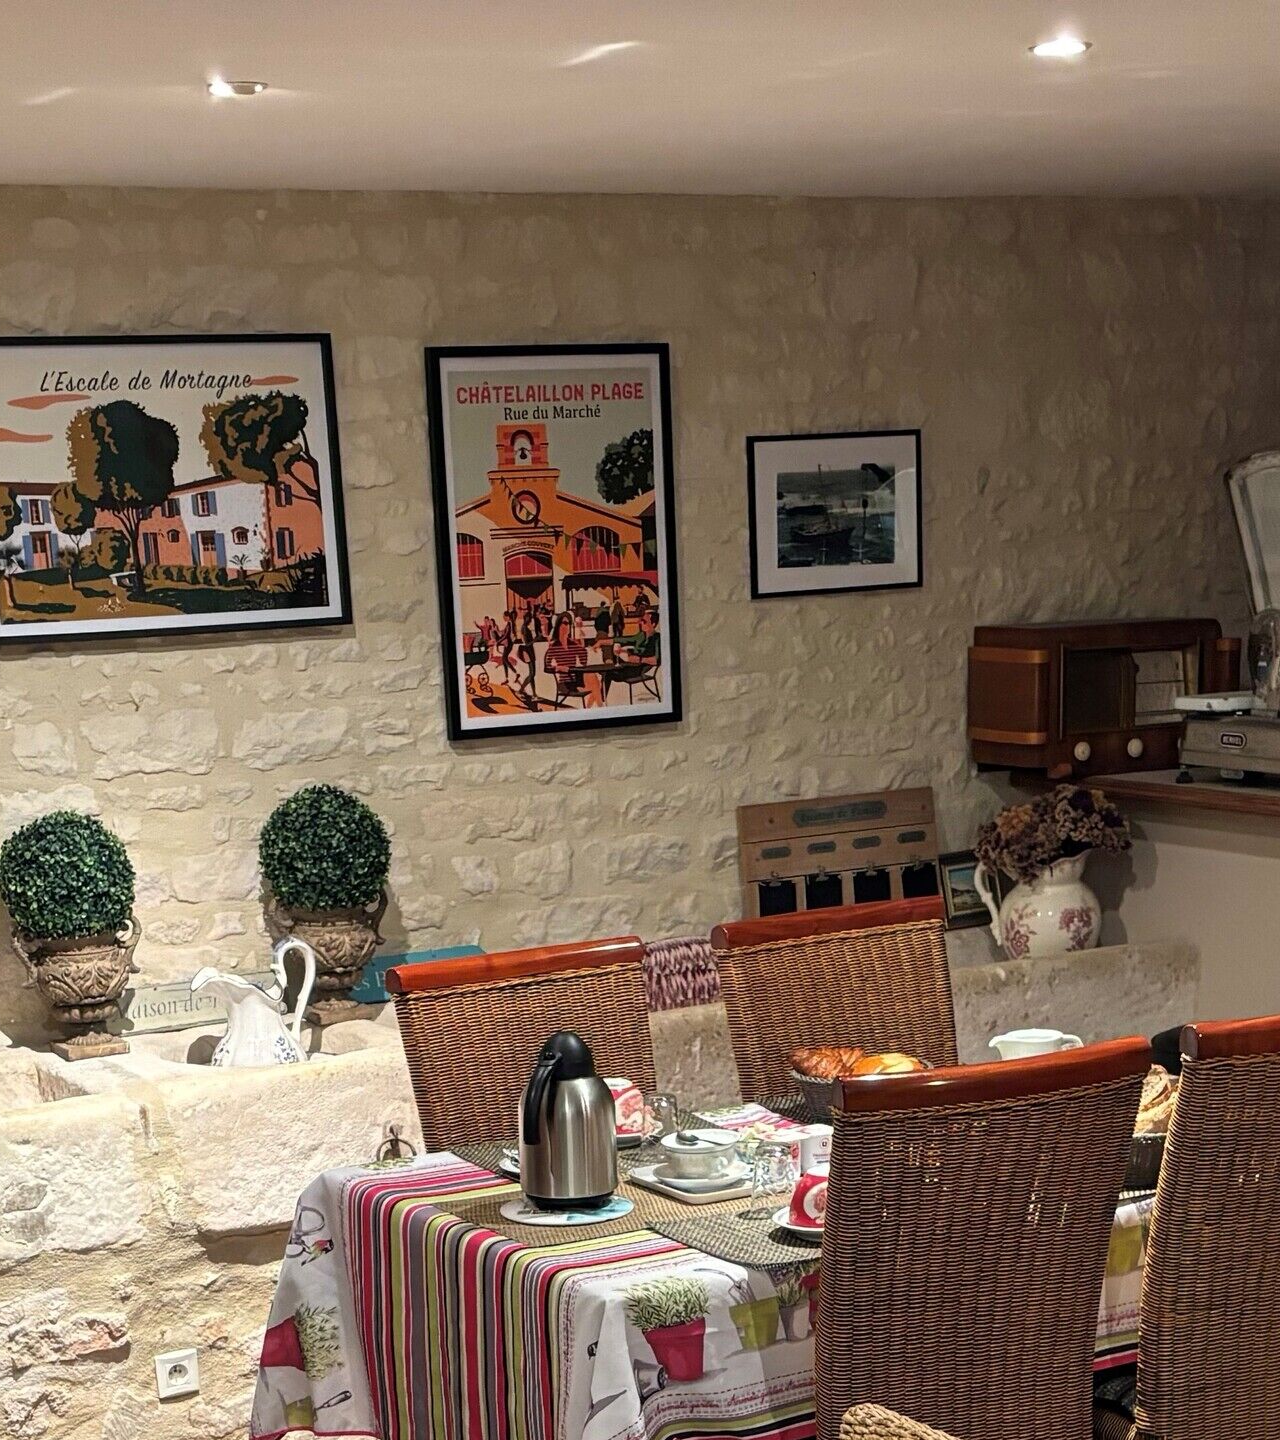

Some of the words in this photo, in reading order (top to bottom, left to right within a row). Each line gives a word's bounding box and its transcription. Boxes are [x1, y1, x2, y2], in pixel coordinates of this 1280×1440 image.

[39, 369, 120, 392] L'Escale
[128, 369, 152, 390] de
[159, 368, 253, 398] Mortagne
[456, 381, 584, 404] CHÂTELAILLON
[591, 382, 644, 401] PLAGE
[503, 406, 529, 421] Rue
[532, 405, 549, 420] du
[552, 403, 601, 420] Marché
